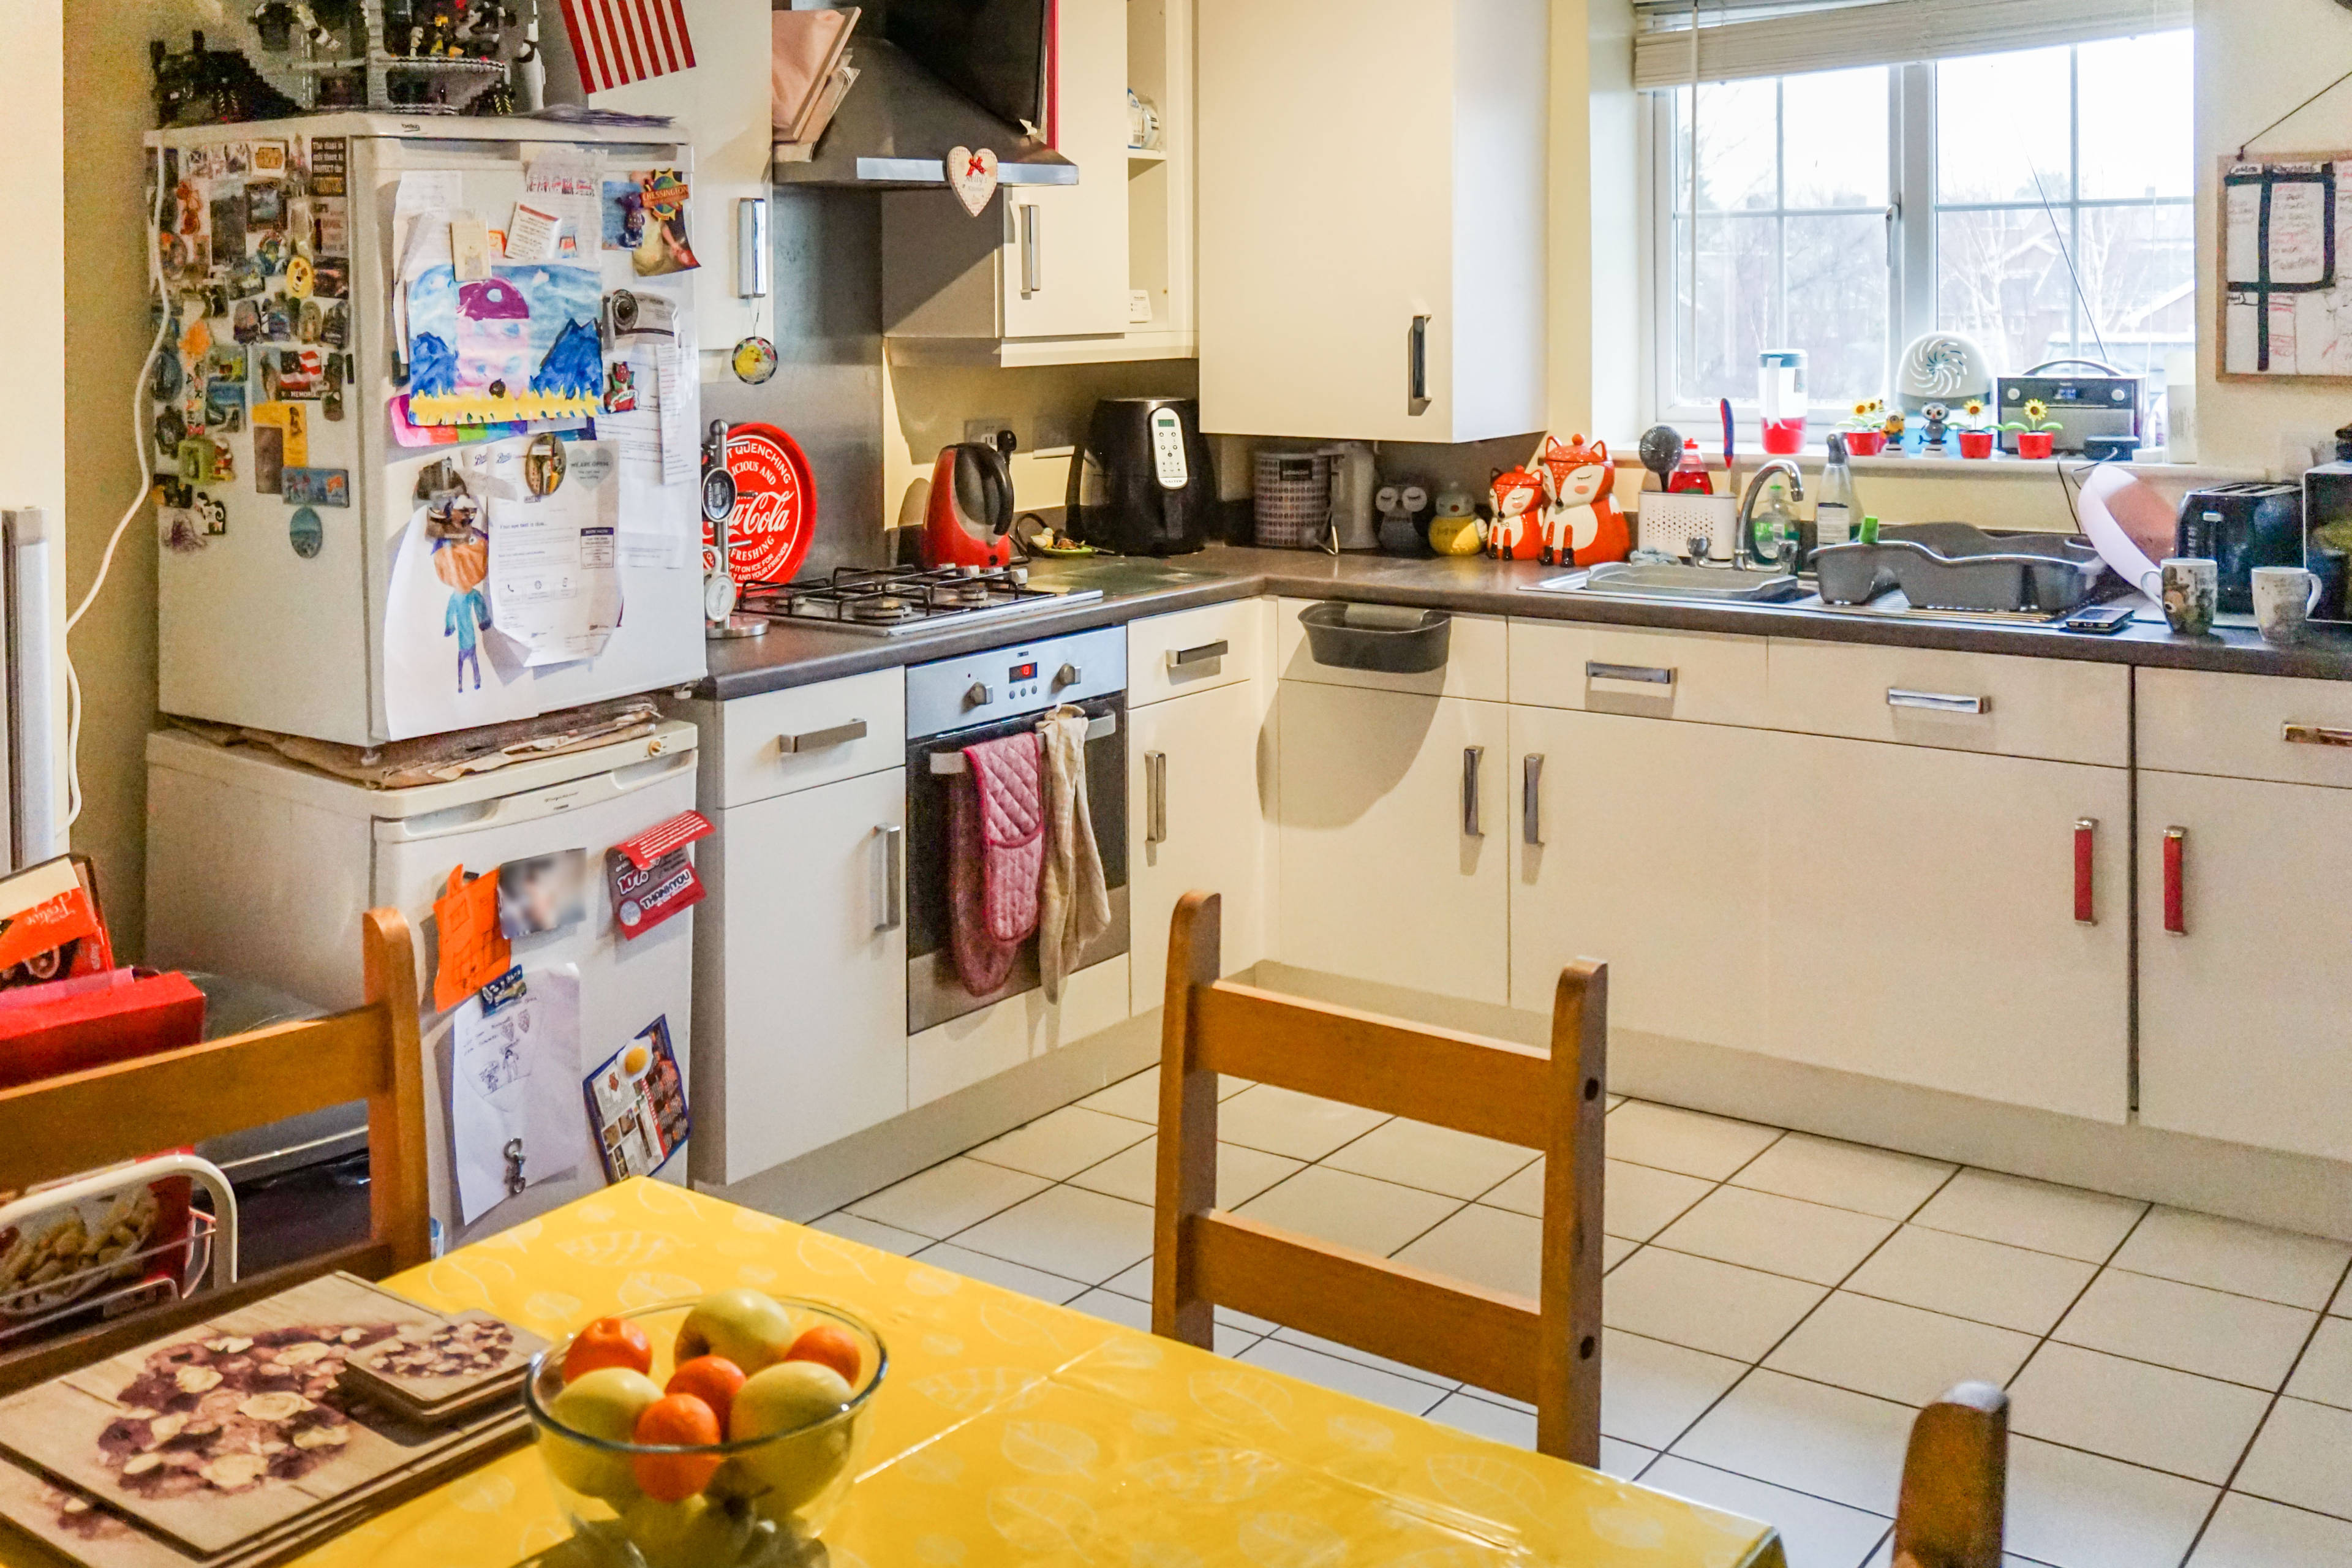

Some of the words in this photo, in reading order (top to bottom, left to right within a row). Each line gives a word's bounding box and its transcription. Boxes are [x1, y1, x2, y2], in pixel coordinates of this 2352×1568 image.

[641, 185, 687, 201] CHESSINGTON
[731, 461, 759, 477] ICIOUS
[760, 466, 776, 485] AND
[735, 443, 791, 484] QUENCHING
[729, 535, 774, 561] FRESHING
